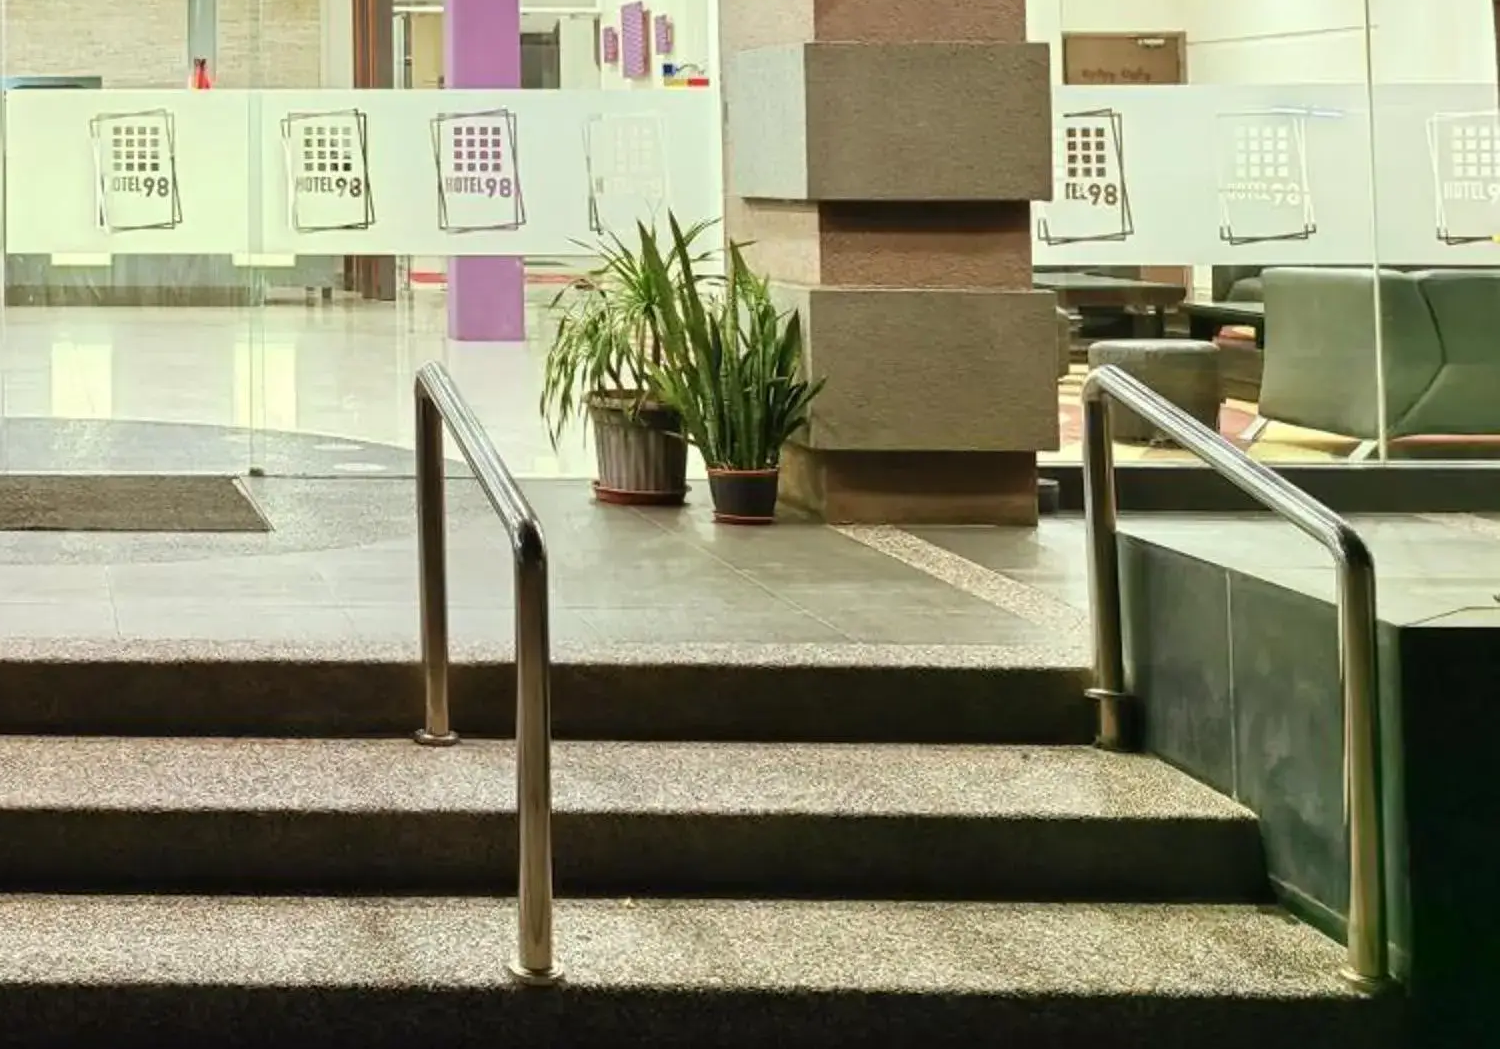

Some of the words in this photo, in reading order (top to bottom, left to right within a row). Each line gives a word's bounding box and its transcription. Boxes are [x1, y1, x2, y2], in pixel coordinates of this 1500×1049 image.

[143, 176, 169, 197] 98
[295, 176, 334, 193] HOTEL
[335, 177, 362, 198] 98
[445, 177, 485, 193] HOTEL
[485, 177, 511, 198] 98
[1088, 182, 1118, 206] 98
